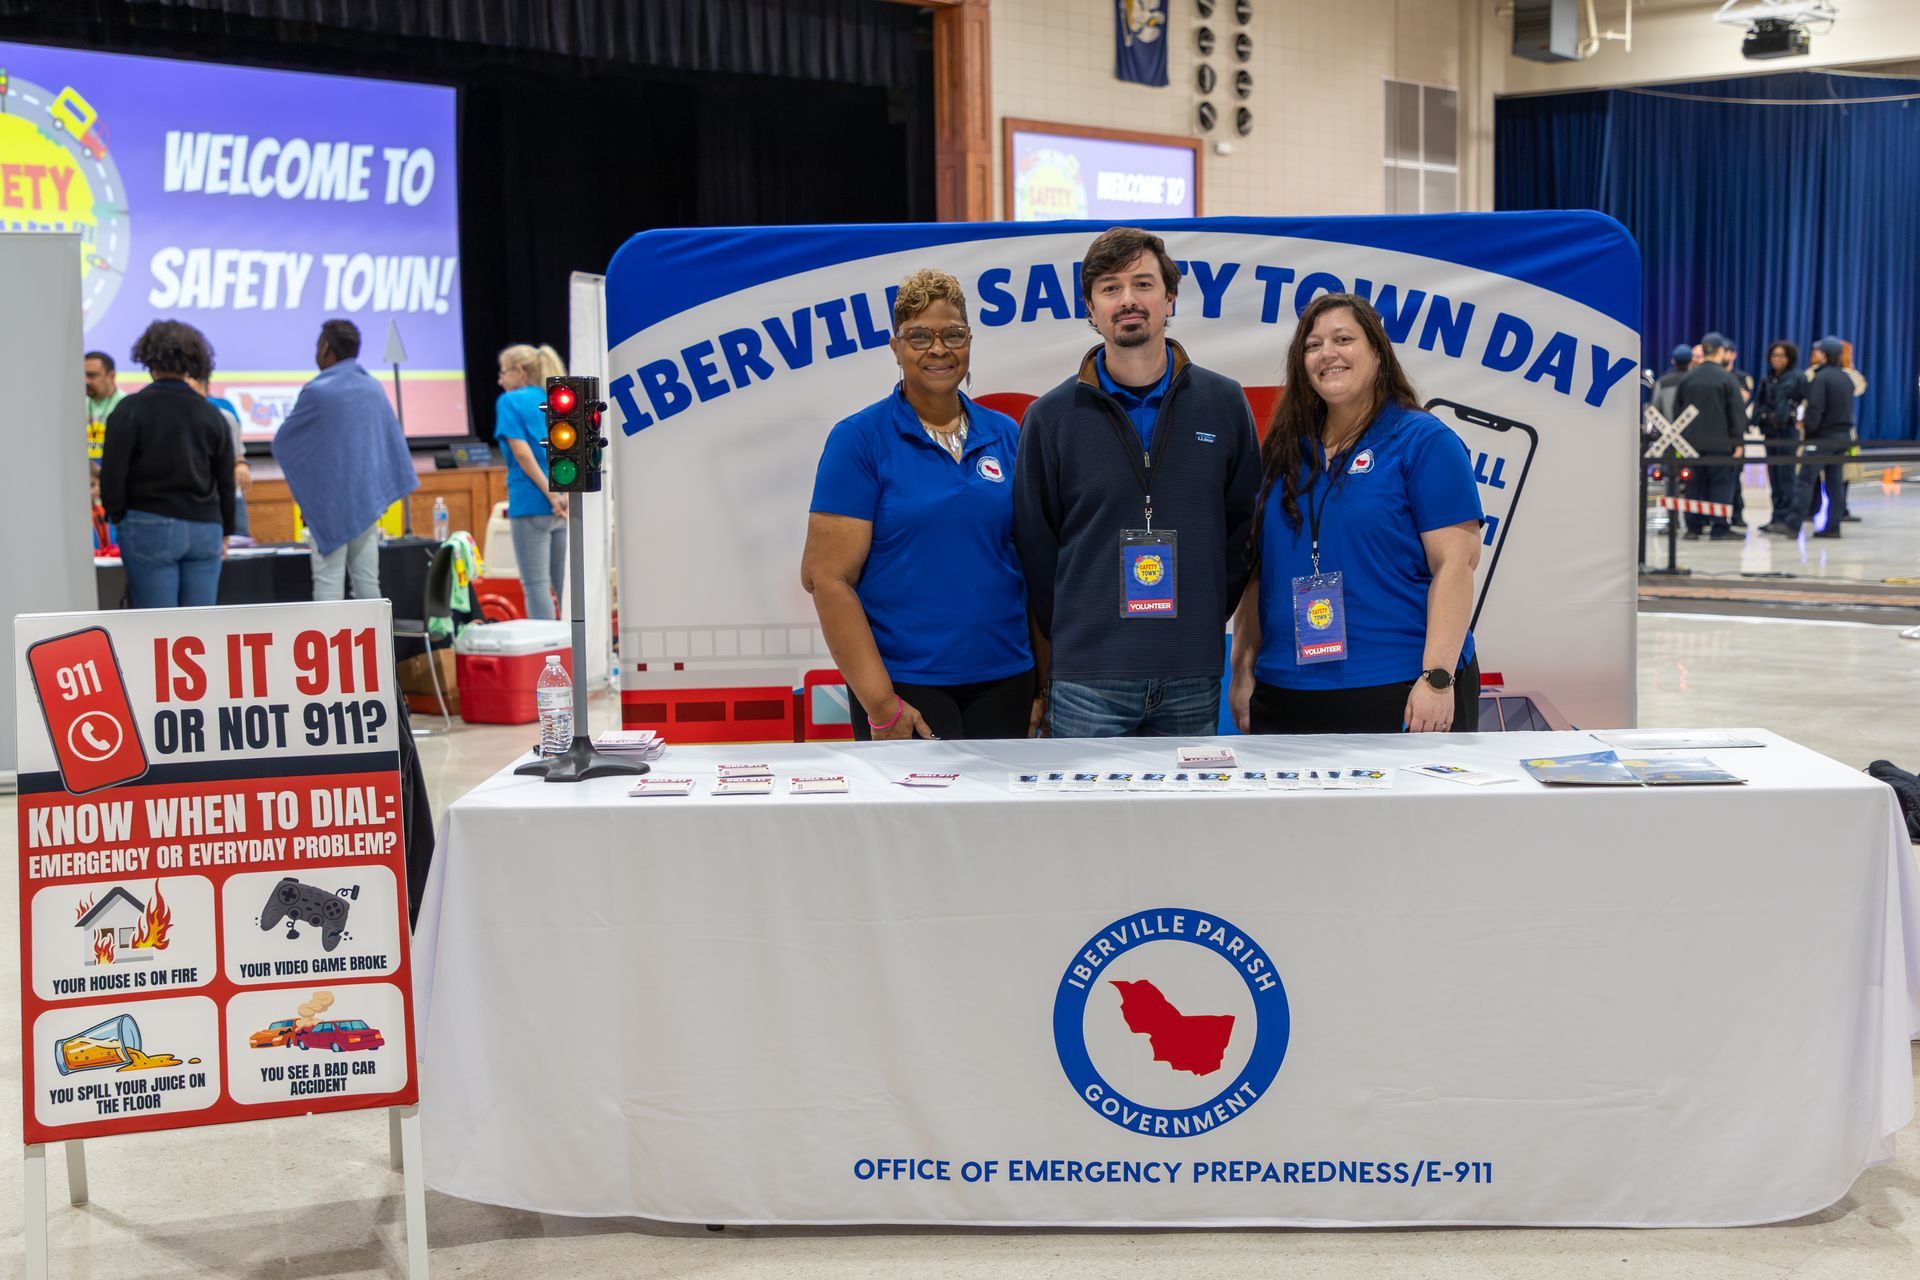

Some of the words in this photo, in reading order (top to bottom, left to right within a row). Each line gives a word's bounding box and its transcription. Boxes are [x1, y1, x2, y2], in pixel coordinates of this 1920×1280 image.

[164, 130, 373, 201] WELCOME
[384, 149, 434, 206] TO
[0, 163, 74, 212] ETY
[1097, 171, 1166, 204] WELCOME
[1166, 176, 1185, 206] TO
[148, 247, 313, 310] SAFETY
[322, 253, 455, 314] TOWN!
[609, 285, 900, 437] IBERVIL
[978, 261, 1241, 327] SAY
[1255, 266, 1475, 358] TOWN
[1482, 312, 1637, 407] DAY
[1474, 452, 1506, 490] LL
[1139, 563, 1158, 571] SAFETY
[1130, 602, 1171, 610] VOLUNTEER
[154, 636, 207, 703] IS
[227, 633, 273, 699] IT
[294, 628, 378, 695] 911
[1304, 645, 1341, 655] VOLUNTEER
[57, 660, 101, 700] 911
[155, 709, 204, 754] OR
[219, 704, 289, 750] NOT
[304, 700, 386, 746] 911?
[29, 801, 133, 847] KNOW
[146, 794, 246, 836] WHEN
[257, 791, 298, 830] TO
[311, 787, 395, 827] DIAL:
[30, 848, 149, 878] EMERGENCY
[157, 845, 182, 868] OR
[190, 838, 286, 866] EVERYDAY
[294, 832, 396, 859] PROBLEM?
[240, 963, 270, 978] YOUR
[275, 960, 308, 975] VIDEO
[313, 957, 346, 972] GAME
[350, 955, 387, 970] BROKE
[1068, 914, 1186, 991] IBERVILLE
[1195, 918, 1276, 993] PARISH
[53, 978, 85, 994] YOUR
[91, 974, 130, 991] HOUSE
[135, 972, 146, 987] IS
[151, 970, 166, 985] ON
[172, 968, 197, 983] FIRE
[50, 1088, 73, 1104] YOU
[78, 1084, 111, 1100] SPILL
[115, 1079, 146, 1096] YOUR
[151, 1075, 185, 1092] JUICE
[190, 1073, 205, 1087] ON
[261, 1067, 283, 1082] YOU
[288, 1065, 309, 1079] SEE
[313, 1064, 320, 1077] A
[325, 1062, 348, 1076] BAD
[353, 1061, 375, 1075] CAR
[291, 1078, 347, 1095] ACCIDENT
[97, 1098, 119, 1114] THE
[123, 1094, 160, 1111] FLOOR
[1084, 1081, 1258, 1136] GOVERNMENT
[854, 1159, 949, 1180] OFFICE
[962, 1161, 997, 1182] OF
[1009, 1161, 1180, 1182] EMERGENCY
[1194, 1161, 1491, 1185] PREPAREDNESS/E-911
